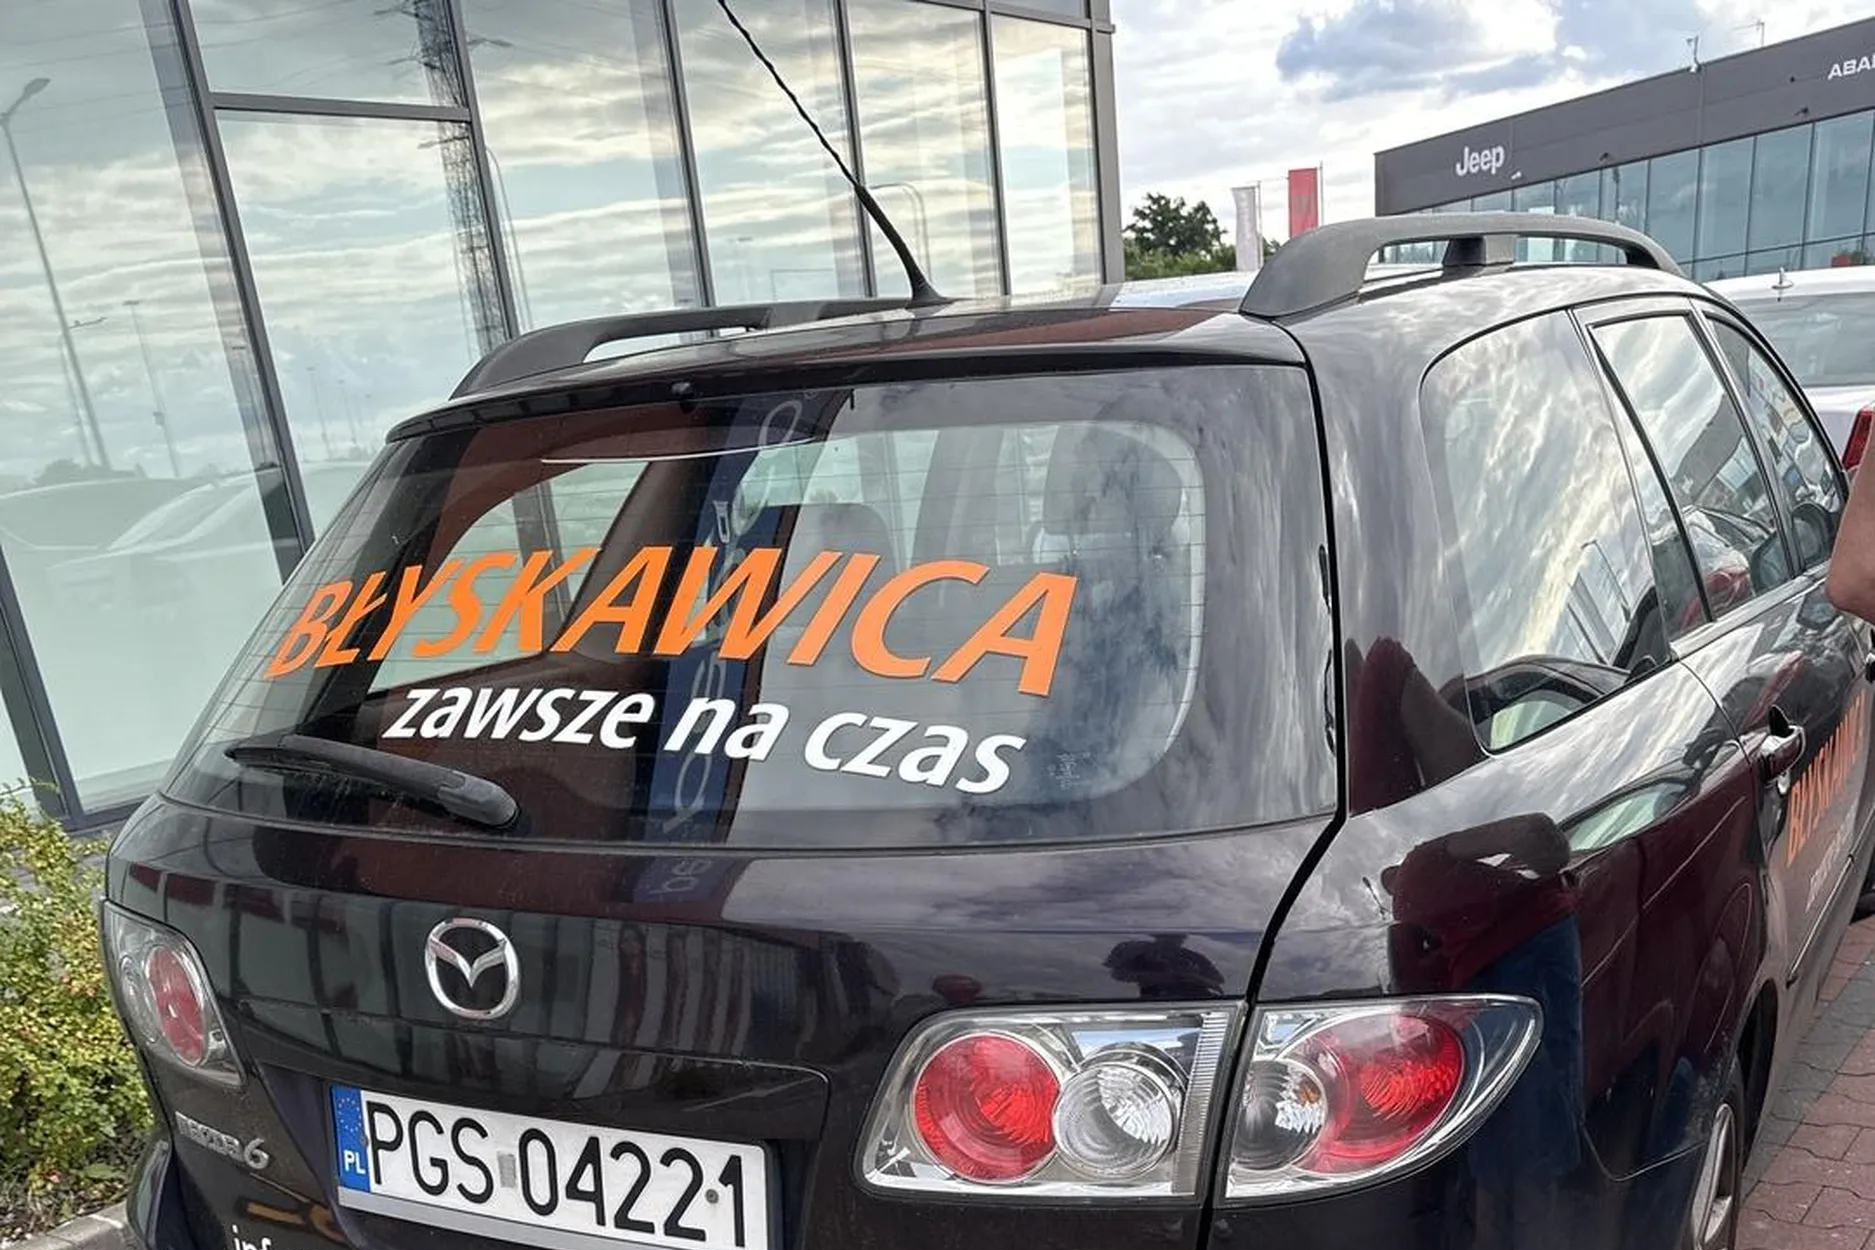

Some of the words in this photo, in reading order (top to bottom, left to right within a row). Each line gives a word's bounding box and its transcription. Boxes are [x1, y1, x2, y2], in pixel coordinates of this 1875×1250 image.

[1828, 54, 1875, 80] ABA
[1456, 146, 1505, 176] Jeep
[265, 546, 1077, 696] BŁYSKAWICA
[382, 685, 654, 748] zawsze
[664, 694, 789, 761] na
[804, 712, 1026, 795] czas
[344, 1152, 366, 1175] PL
[366, 1101, 494, 1204] PGS
[518, 1128, 746, 1248] 04221
